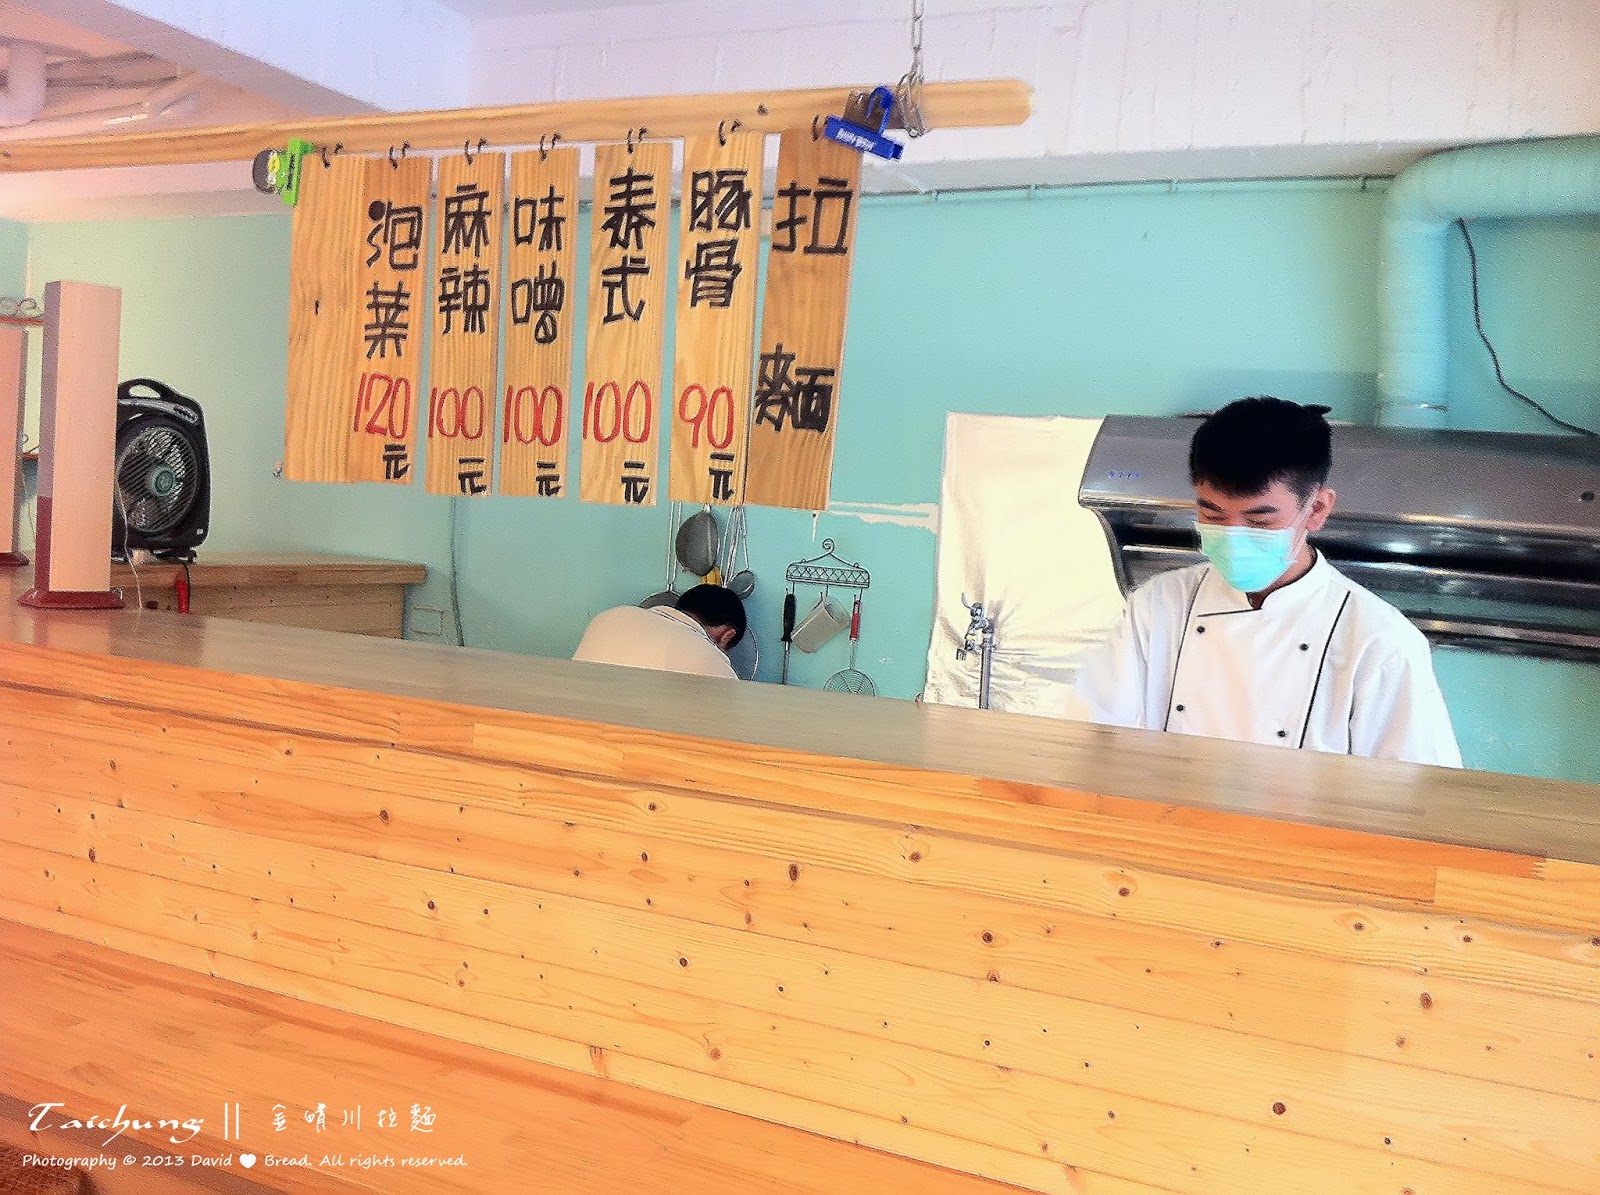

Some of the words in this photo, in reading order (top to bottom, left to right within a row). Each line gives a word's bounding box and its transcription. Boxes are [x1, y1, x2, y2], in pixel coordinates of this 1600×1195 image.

[438, 183, 492, 335] 麻辣
[511, 184, 565, 345] 味噌
[600, 167, 656, 325] 泰式
[684, 169, 751, 309] 豚骨
[364, 200, 423, 359] 泡菜
[754, 177, 854, 432] 拉麵
[353, 372, 411, 439] 120
[428, 385, 485, 440] 100
[503, 384, 564, 446] 100
[582, 380, 652, 443] 100
[678, 383, 735, 449] 90
[382, 444, 411, 480] 元
[458, 457, 487, 495] 元
[536, 461, 562, 497] 元
[621, 460, 650, 503] 元
[709, 453, 735, 500] 元
